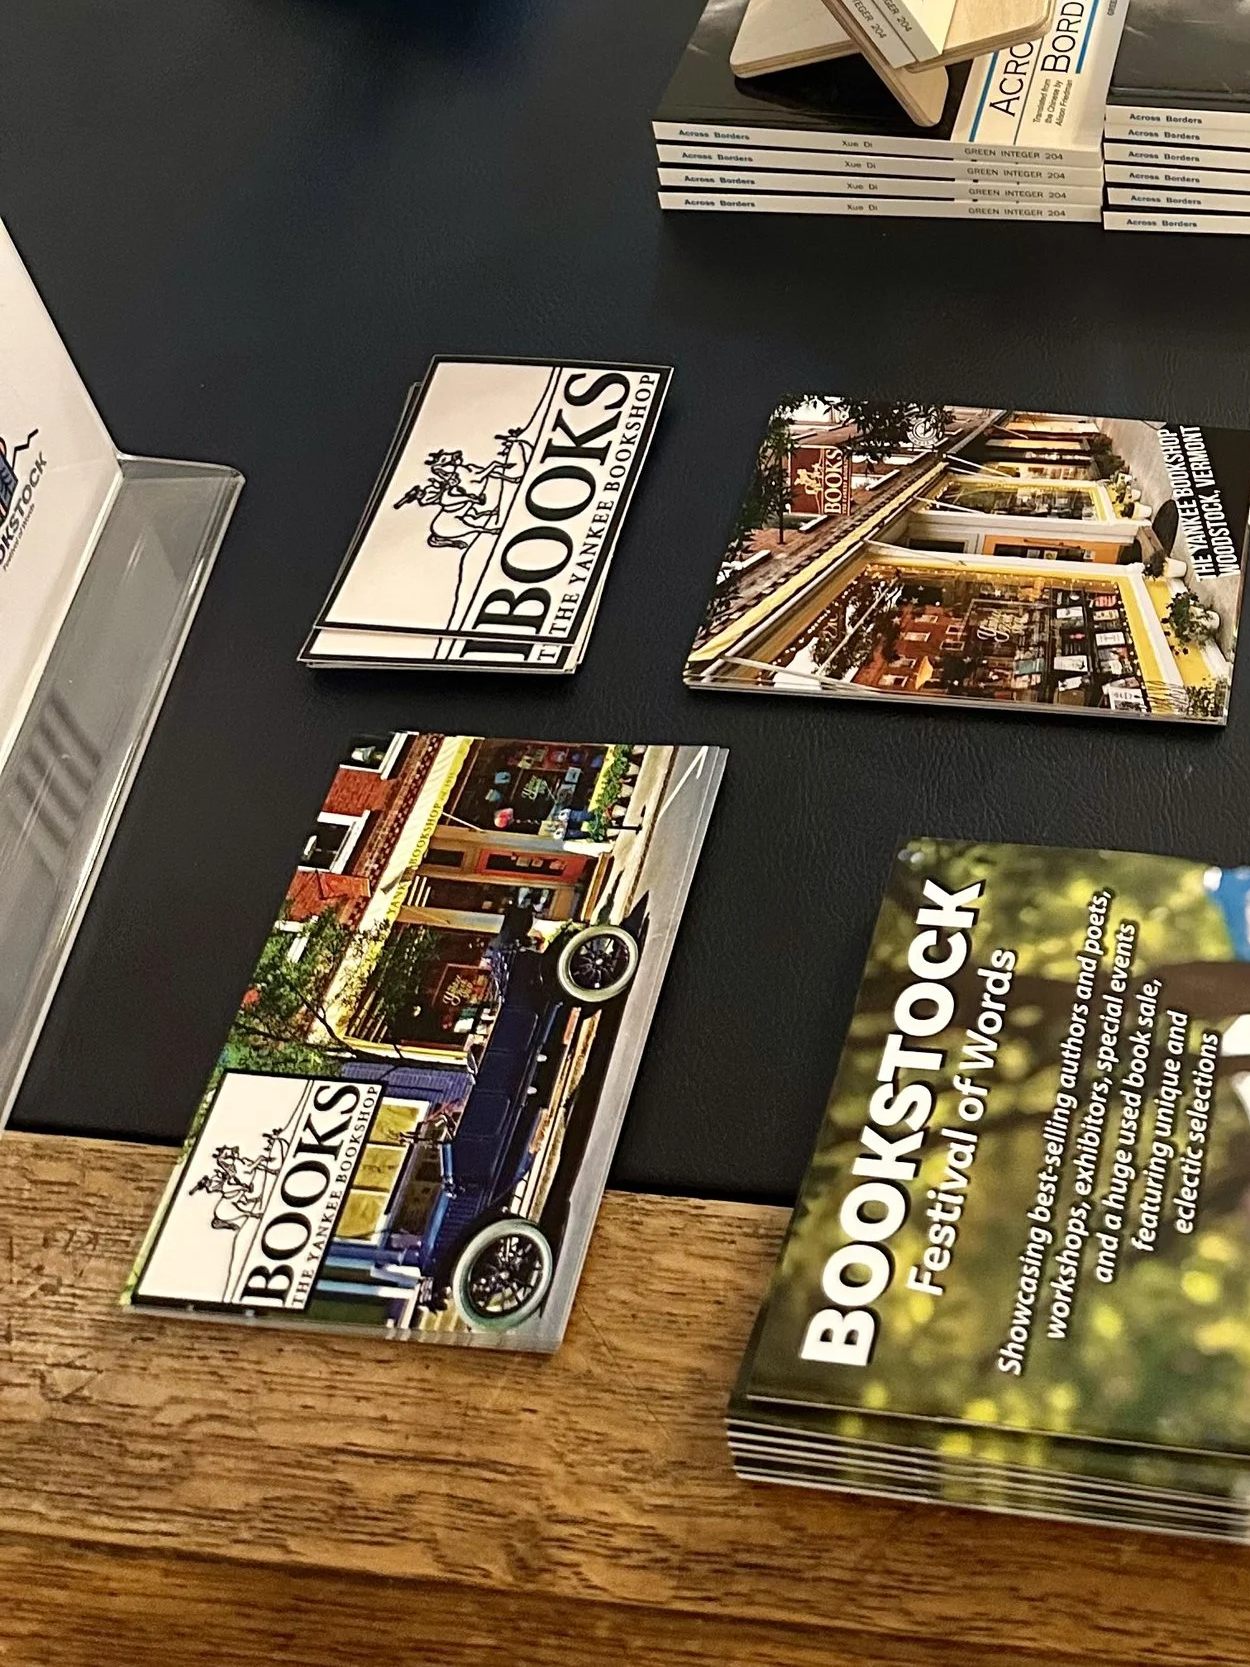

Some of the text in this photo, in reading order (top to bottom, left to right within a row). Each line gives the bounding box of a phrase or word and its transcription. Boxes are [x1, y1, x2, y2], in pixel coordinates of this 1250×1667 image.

[1129, 112, 1161, 123] Across
[1166, 115, 1203, 125] Borders
[471, 372, 631, 636] BOOKS
[550, 374, 656, 637] THE YANKEE BOOKSHOP
[824, 447, 844, 514] BOOKS
[1157, 429, 1218, 582] THE YANKEE BOOKSHOP
[1180, 425, 1241, 578] WOODSTOCK, VERMONT
[239, 1085, 361, 1306] BOOKS
[292, 1086, 381, 1308] THE YANKEE BOOKSHOP
[800, 879, 985, 1366] BOOKSTOCK
[906, 949, 1018, 1296] Festival of Words
[998, 887, 1113, 1375] Showcasing best-selling authors and poets,
[1047, 921, 1137, 1339] workshops, exhibitors, special events
[1095, 977, 1163, 1284] and a huge used book sale,
[1130, 1010, 1189, 1253] featuring unique and
[1173, 1031, 1220, 1235] eclectic selections
